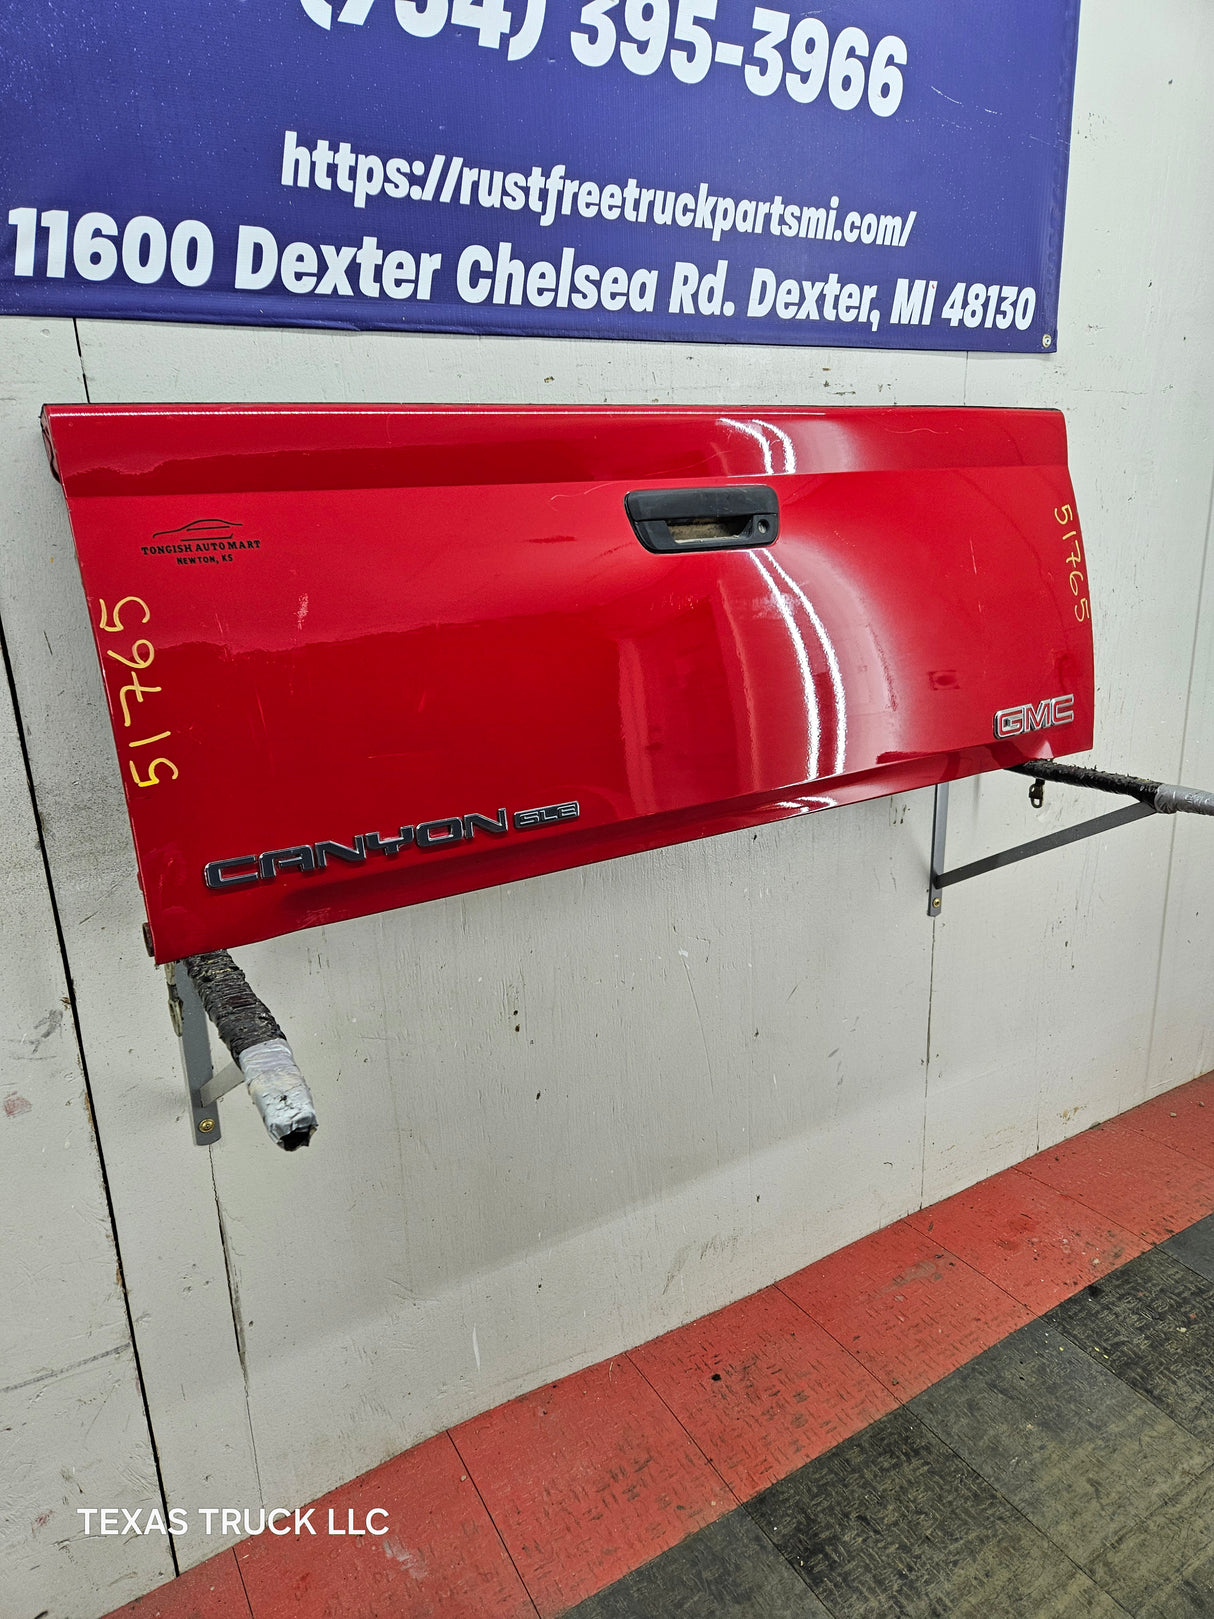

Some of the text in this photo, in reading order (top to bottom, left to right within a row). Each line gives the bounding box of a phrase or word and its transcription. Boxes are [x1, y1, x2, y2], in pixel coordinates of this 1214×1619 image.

[571, 0, 908, 117] 395-3966
[281, 131, 917, 247] https://rustfreetruckpartsmi.com/
[8, 208, 1037, 331] 11600 Dexter Chelsea Rd. Dexter, MI 48130
[141, 539, 261, 555] TONGISH AUTO MART
[176, 554, 233, 565] NEWTON, KS
[1054, 503, 1090, 622] 51765
[99, 596, 179, 788] 51765
[993, 693, 1074, 740] GMC
[204, 801, 579, 888] CANYON SLE
